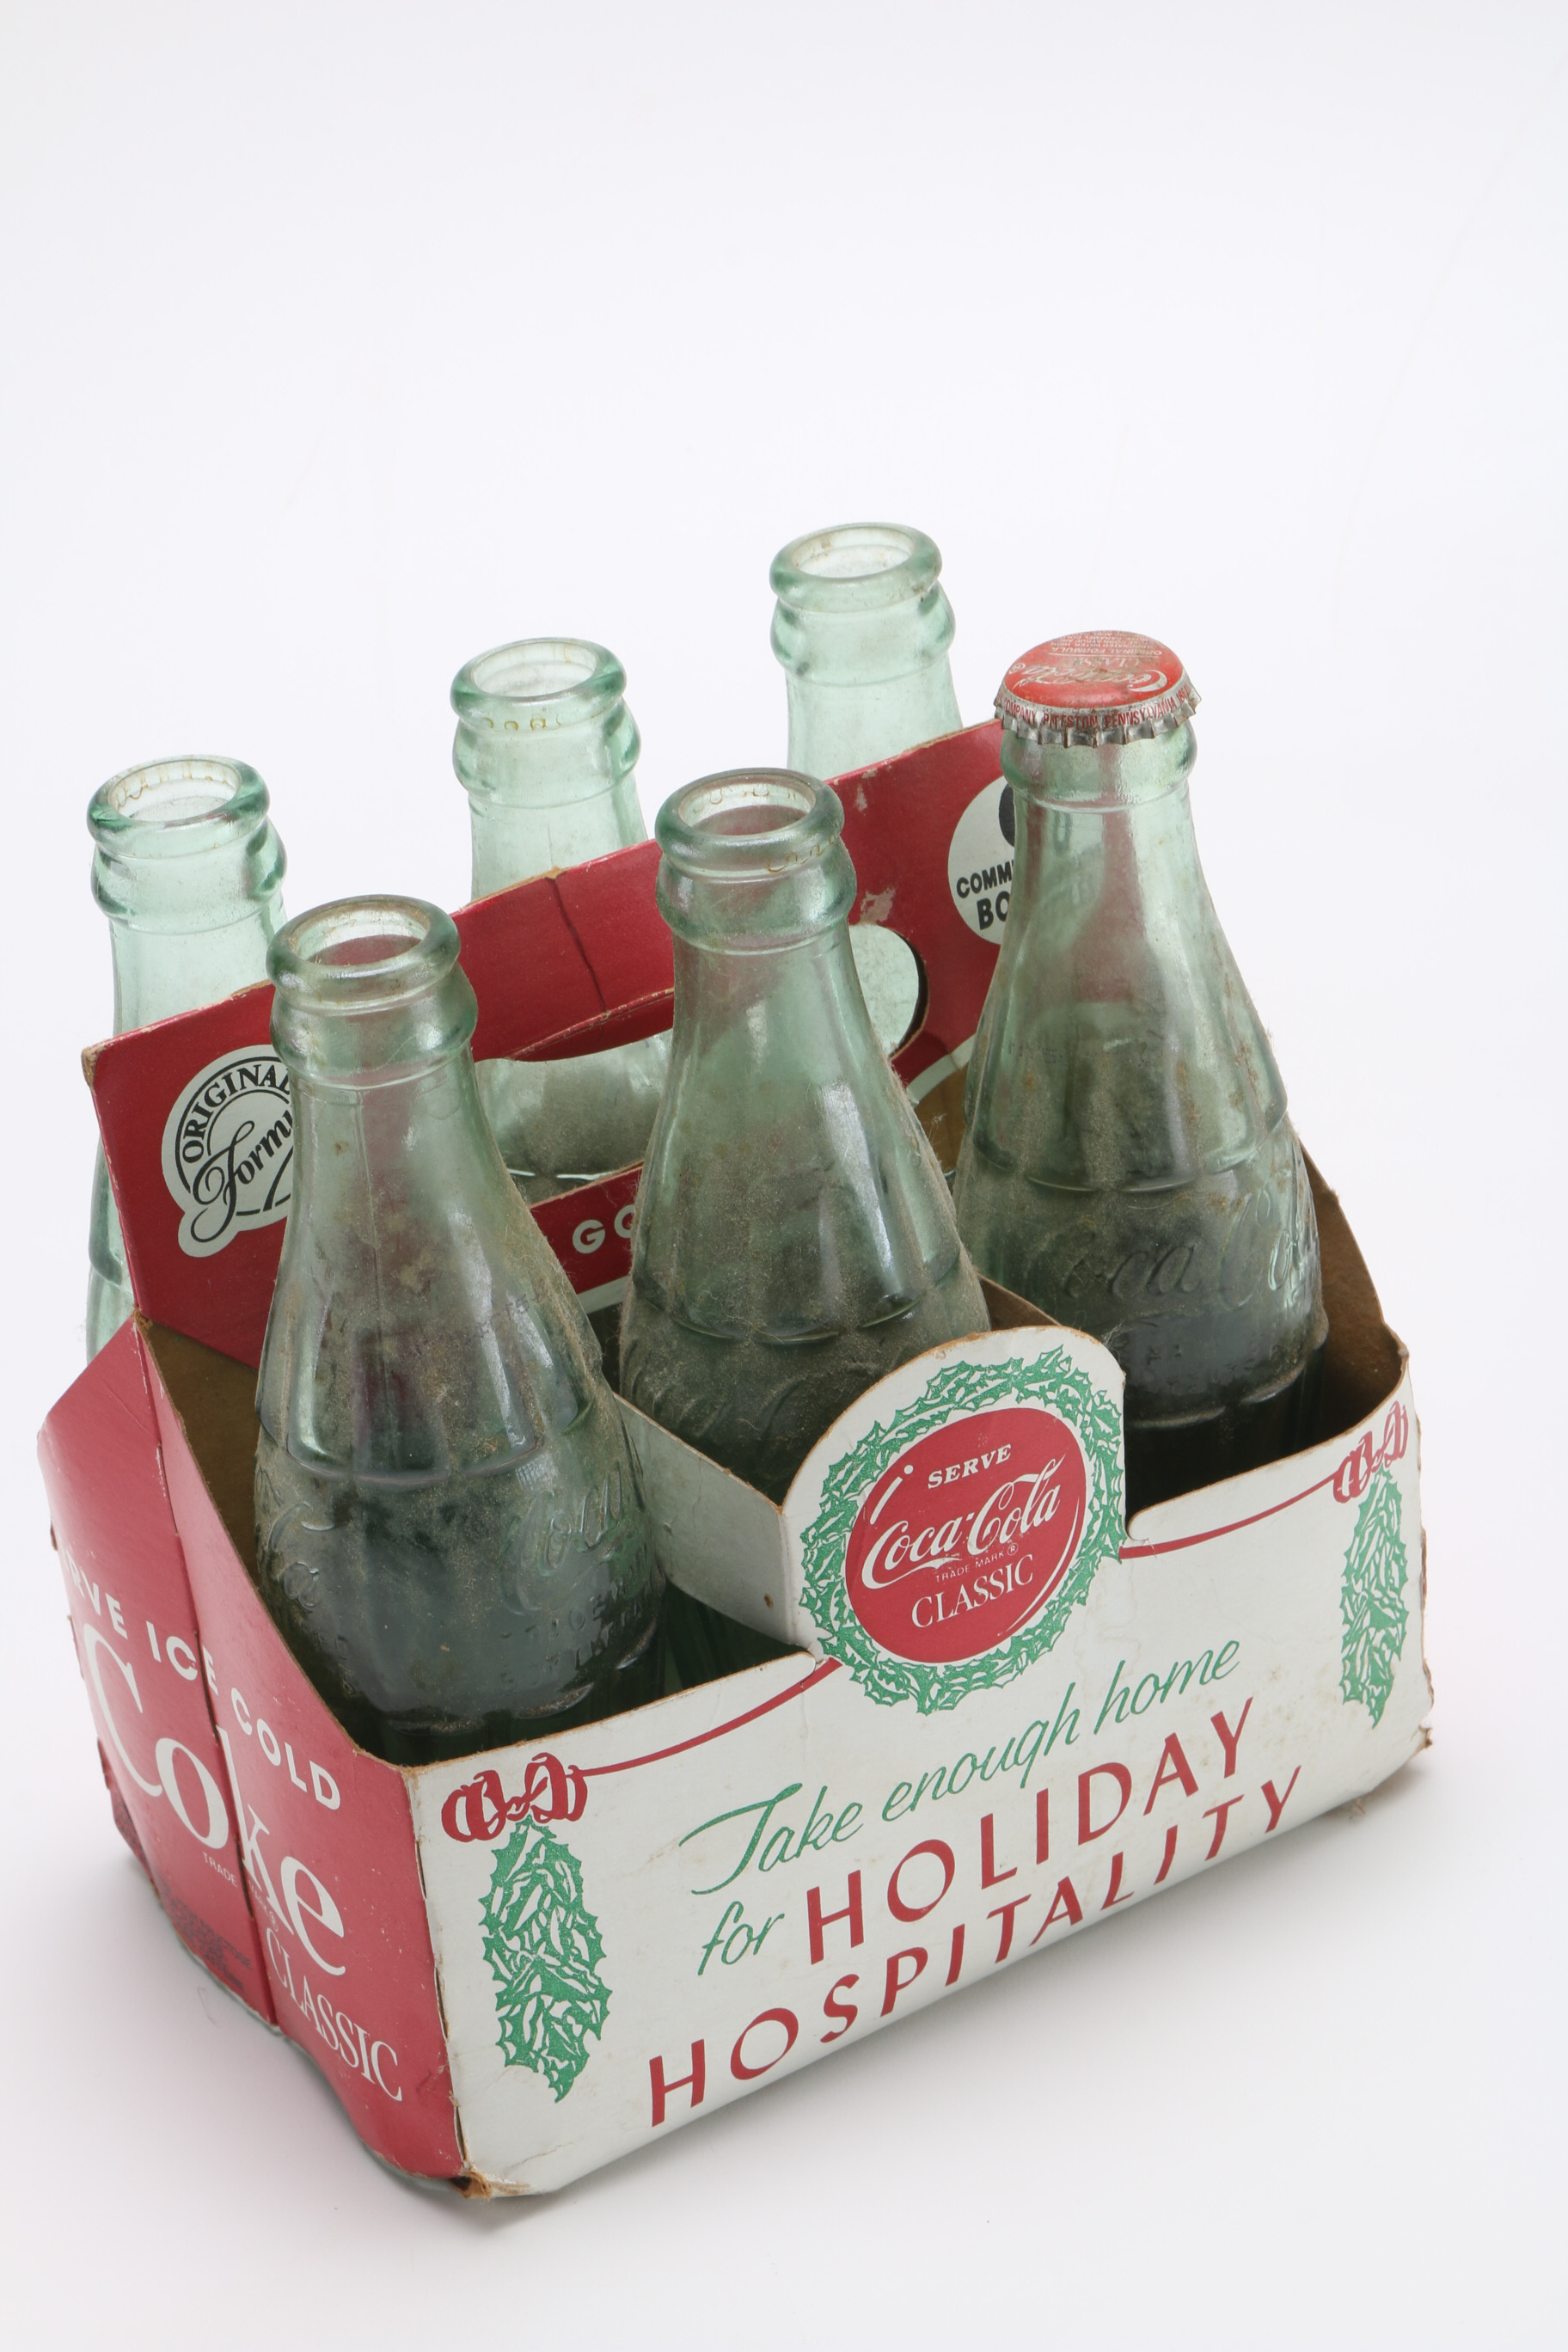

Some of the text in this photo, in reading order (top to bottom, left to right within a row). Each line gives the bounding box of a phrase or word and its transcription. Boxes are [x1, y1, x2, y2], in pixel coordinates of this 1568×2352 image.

[956, 860, 1014, 899] COMM
[861, 1453, 1066, 1589] Coca-Cola
[928, 1443, 1012, 1490] SERVE
[910, 1553, 1034, 1628] CLASSIC
[935, 1565, 971, 1583] TRADE
[975, 1551, 1005, 1568] MARK
[145, 1620, 218, 1696] ICE
[230, 1687, 341, 1810] COLD
[678, 1639, 1240, 1896] Take enough home
[83, 1622, 346, 1976] Coke
[202, 1850, 238, 1888] TRADE
[697, 1696, 1254, 1976] for HOLIDAY
[266, 1927, 403, 2103] CLASSIC
[648, 1764, 1302, 2128] HOSPITALITY
